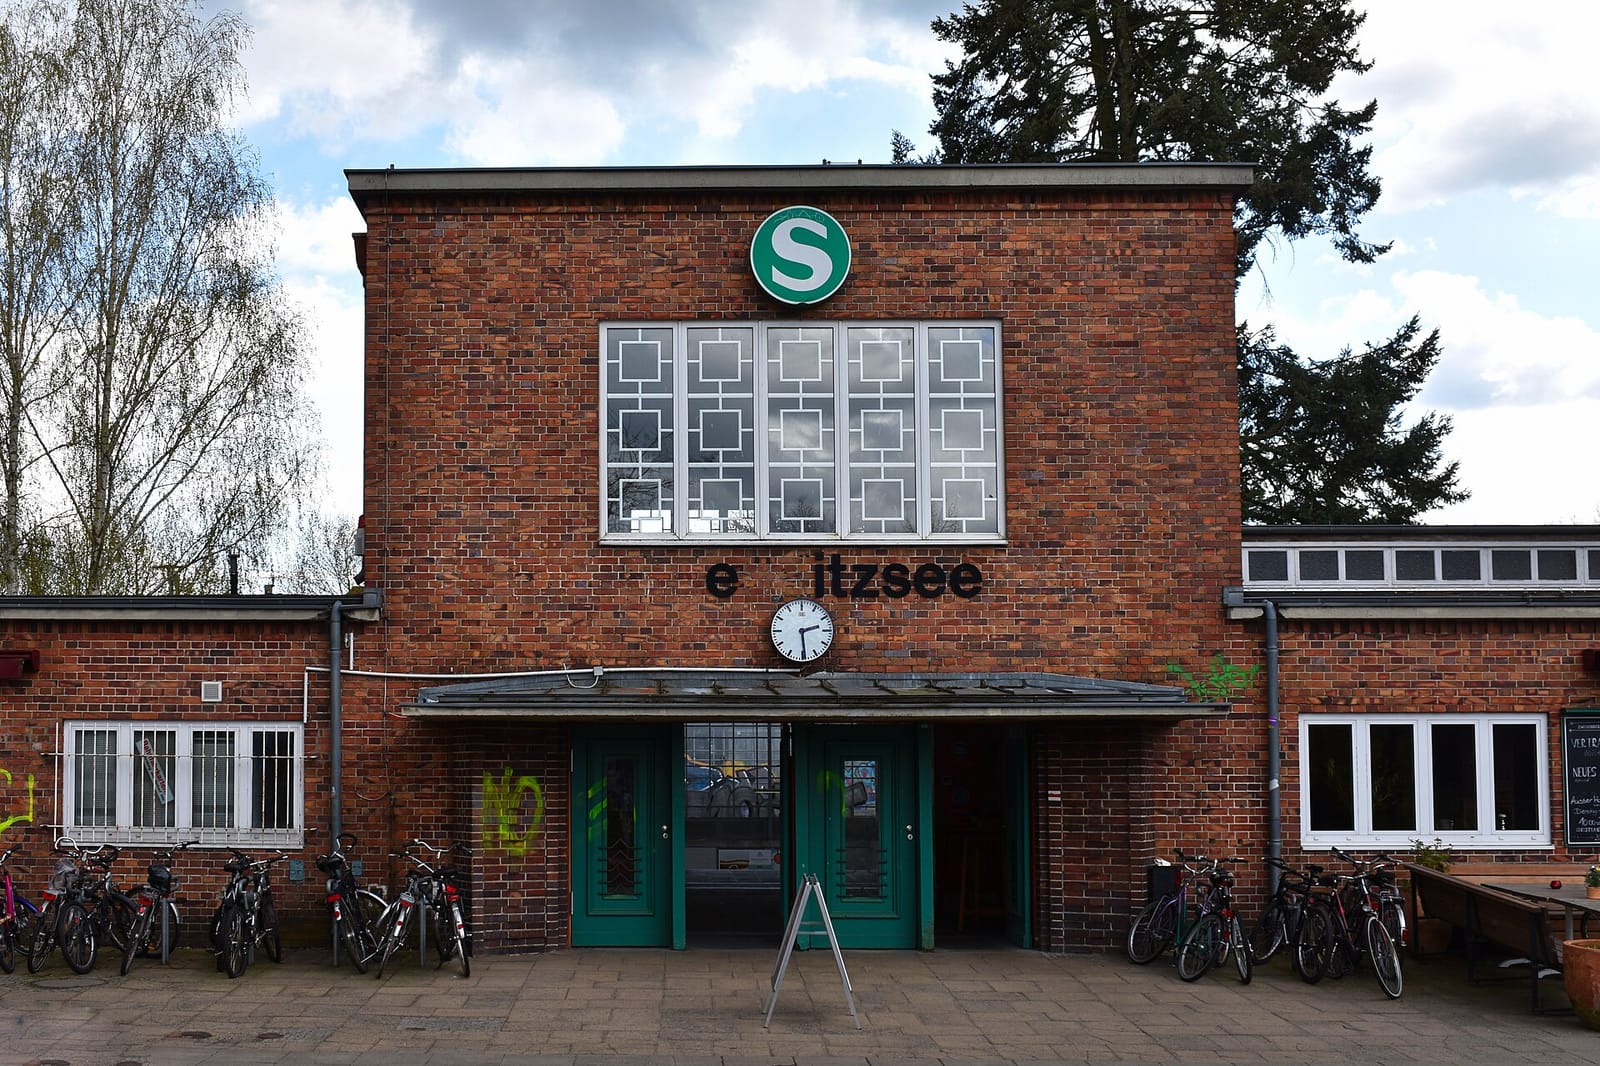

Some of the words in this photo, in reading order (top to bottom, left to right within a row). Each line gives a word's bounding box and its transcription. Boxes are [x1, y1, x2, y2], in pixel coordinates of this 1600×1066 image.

[771, 217, 833, 292] S
[706, 563, 739, 598] e
[814, 551, 983, 598] itzsee
